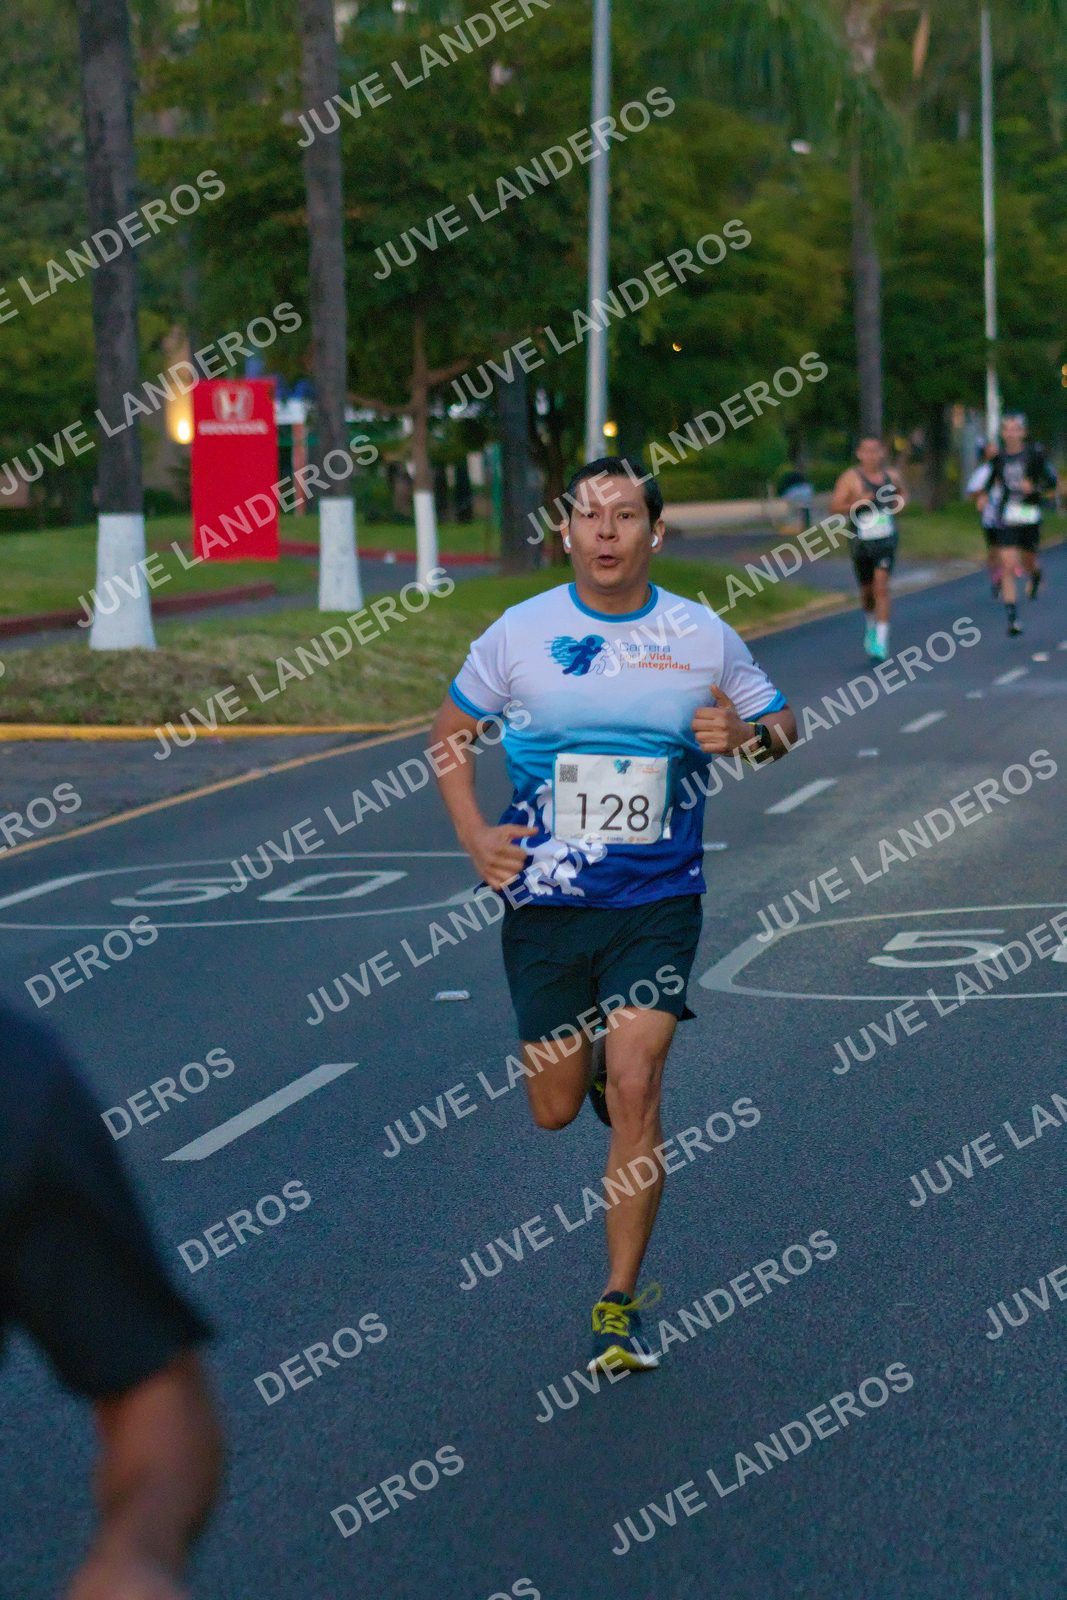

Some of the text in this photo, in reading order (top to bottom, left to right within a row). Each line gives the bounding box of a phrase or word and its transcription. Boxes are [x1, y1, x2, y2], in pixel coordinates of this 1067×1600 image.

[638, 661, 691, 671] Integridad
[649, 653, 672, 661] Vida
[576, 793, 649, 832] 128
[110, 870, 408, 907] 50
[867, 929, 1067, 968] 5
